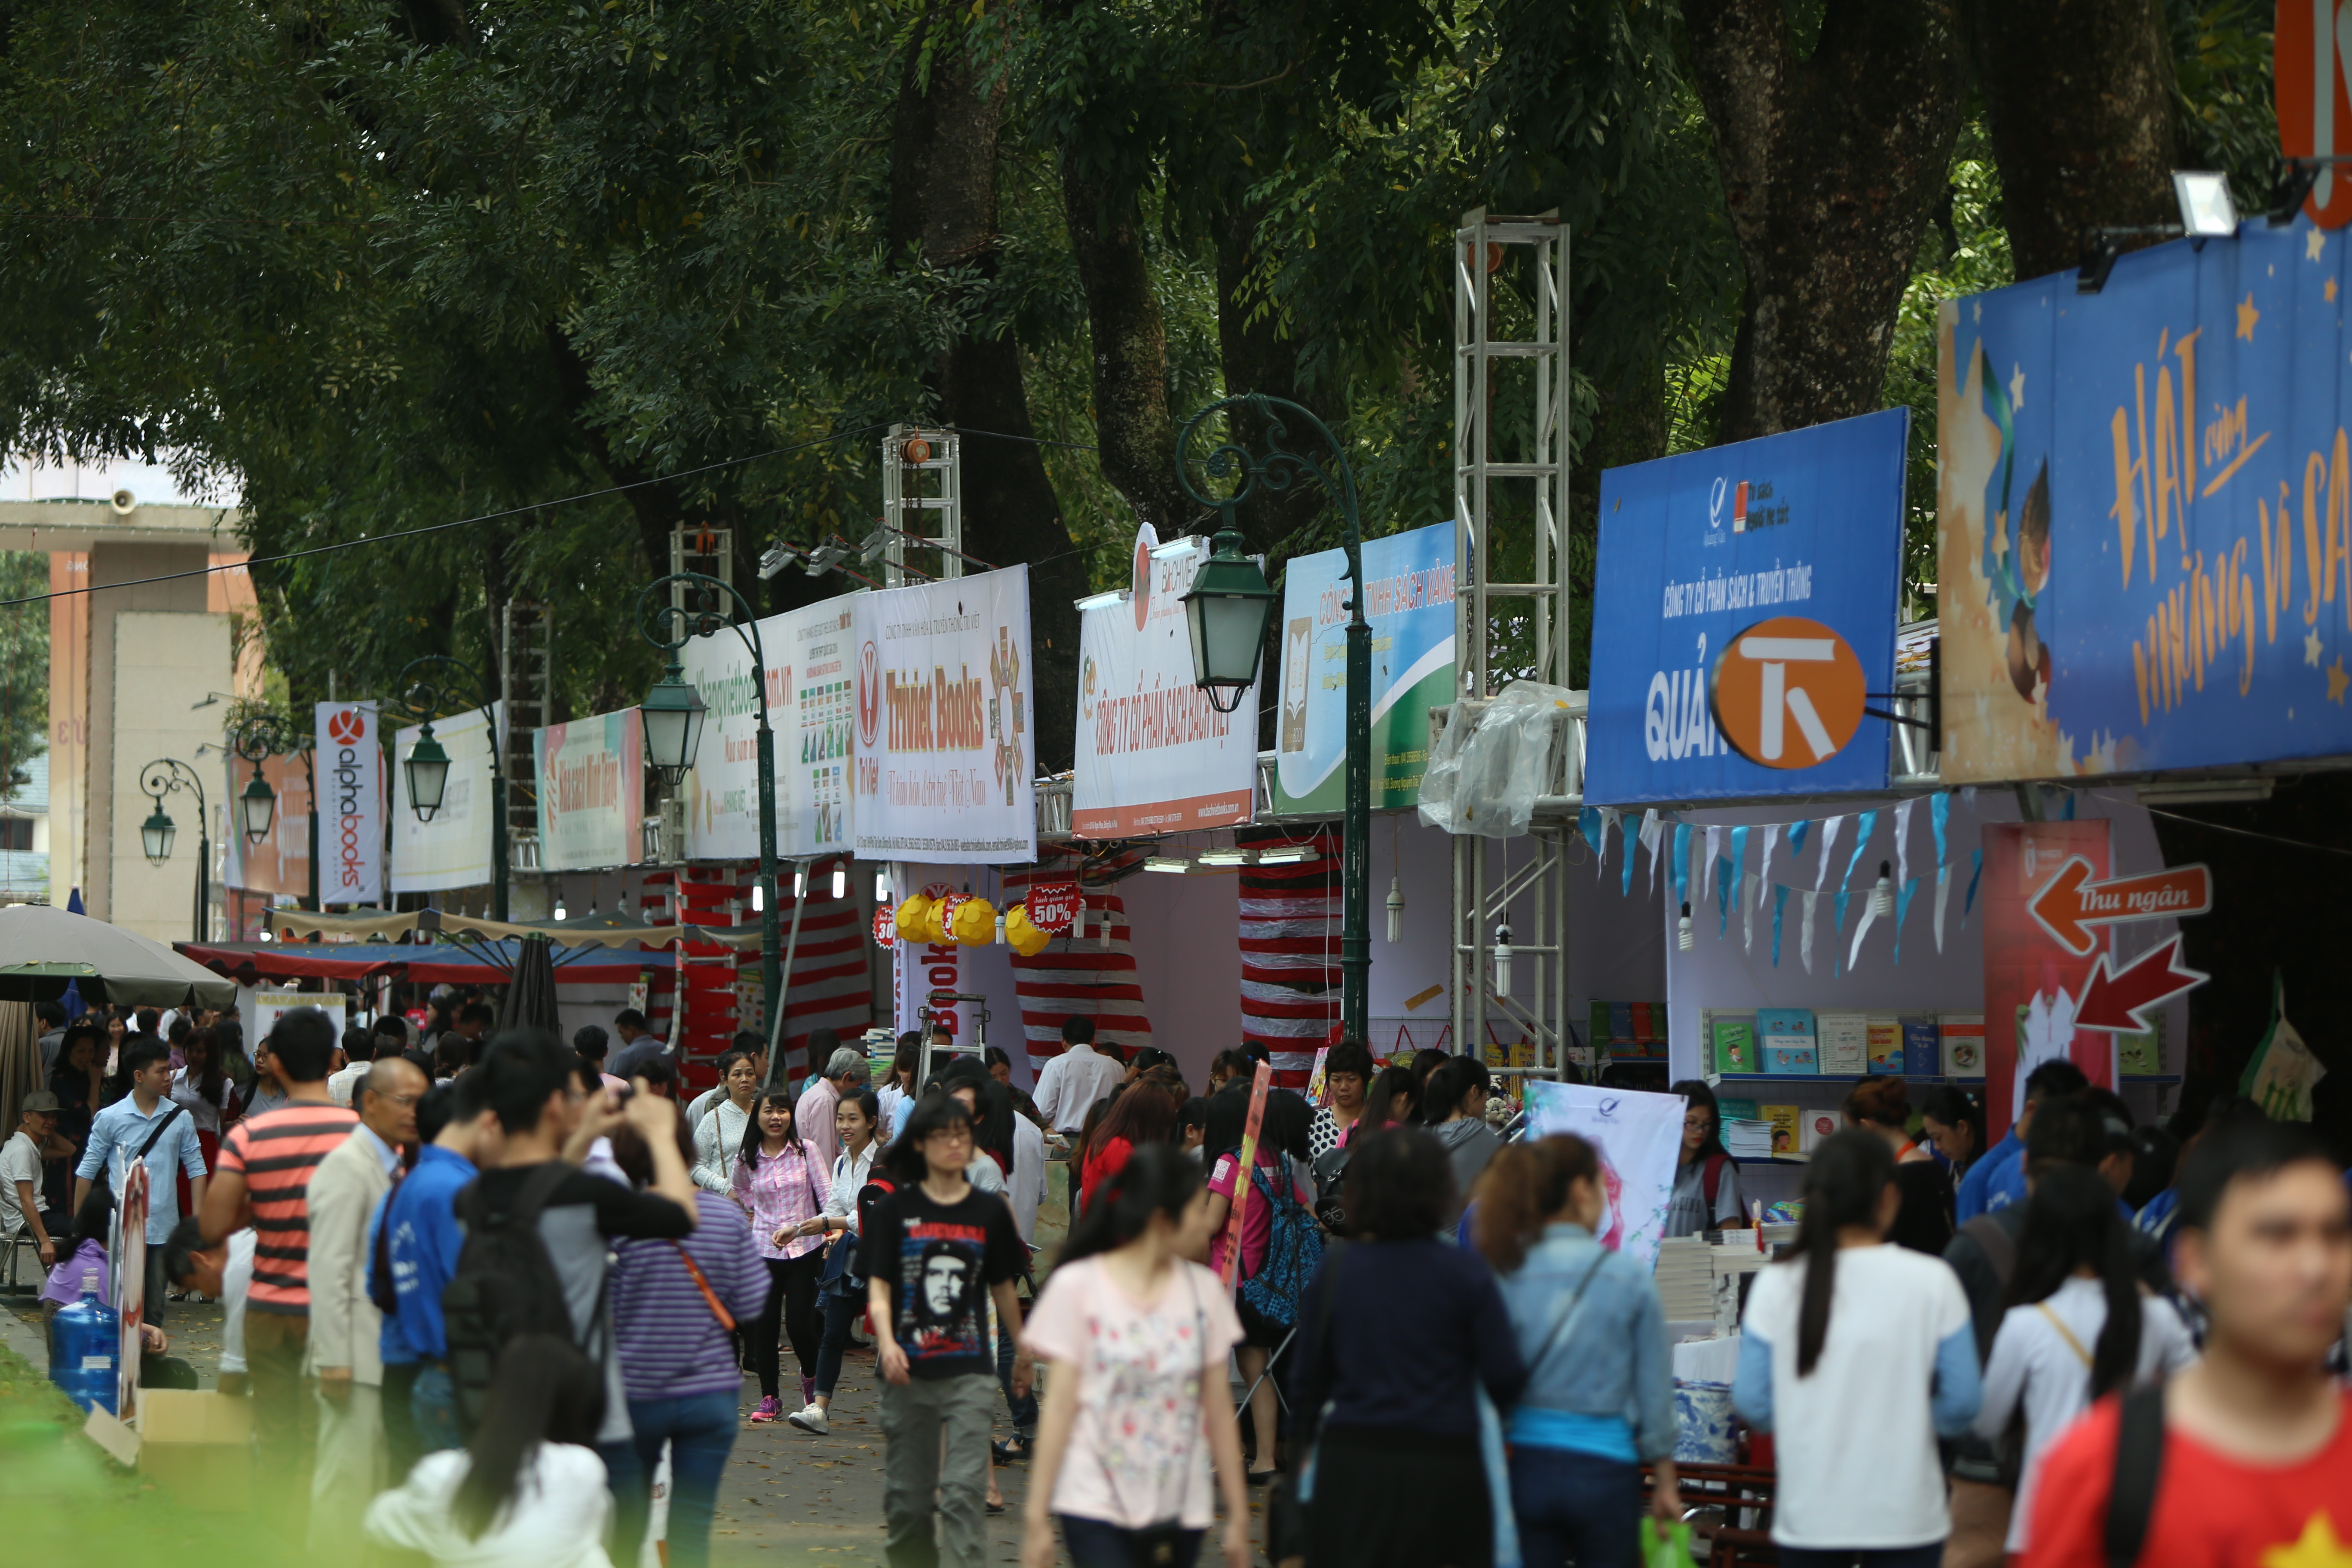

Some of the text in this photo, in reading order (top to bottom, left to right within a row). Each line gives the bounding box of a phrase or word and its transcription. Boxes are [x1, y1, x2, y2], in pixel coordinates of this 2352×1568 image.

[2109, 326, 2202, 592] HÁT
[1319, 583, 1348, 626] CÔNG
[1364, 577, 1393, 619] TNHH
[1393, 565, 1425, 613] SÁCH
[1426, 558, 1456, 606] VÀNG
[1663, 557, 1812, 619] CÔNG TY CỔ PHẦN SÁCH & TRUYỀN THÔNG
[934, 662, 984, 753] Books
[1096, 688, 1118, 756] CÔNG
[1118, 696, 1130, 753] TY
[1130, 669, 1143, 752] CỔ
[1142, 672, 1165, 750] PHẦN
[1165, 675, 1188, 747] SÁCH
[333, 747, 365, 887] alphabooks
[945, 912, 952, 929] 3
[1034, 893, 1075, 903] Sách giảm giá
[1035, 902, 1071, 923] 50%
[2078, 883, 2190, 912] Thu ngân
[909, 1223, 987, 1243] GUEVARA
